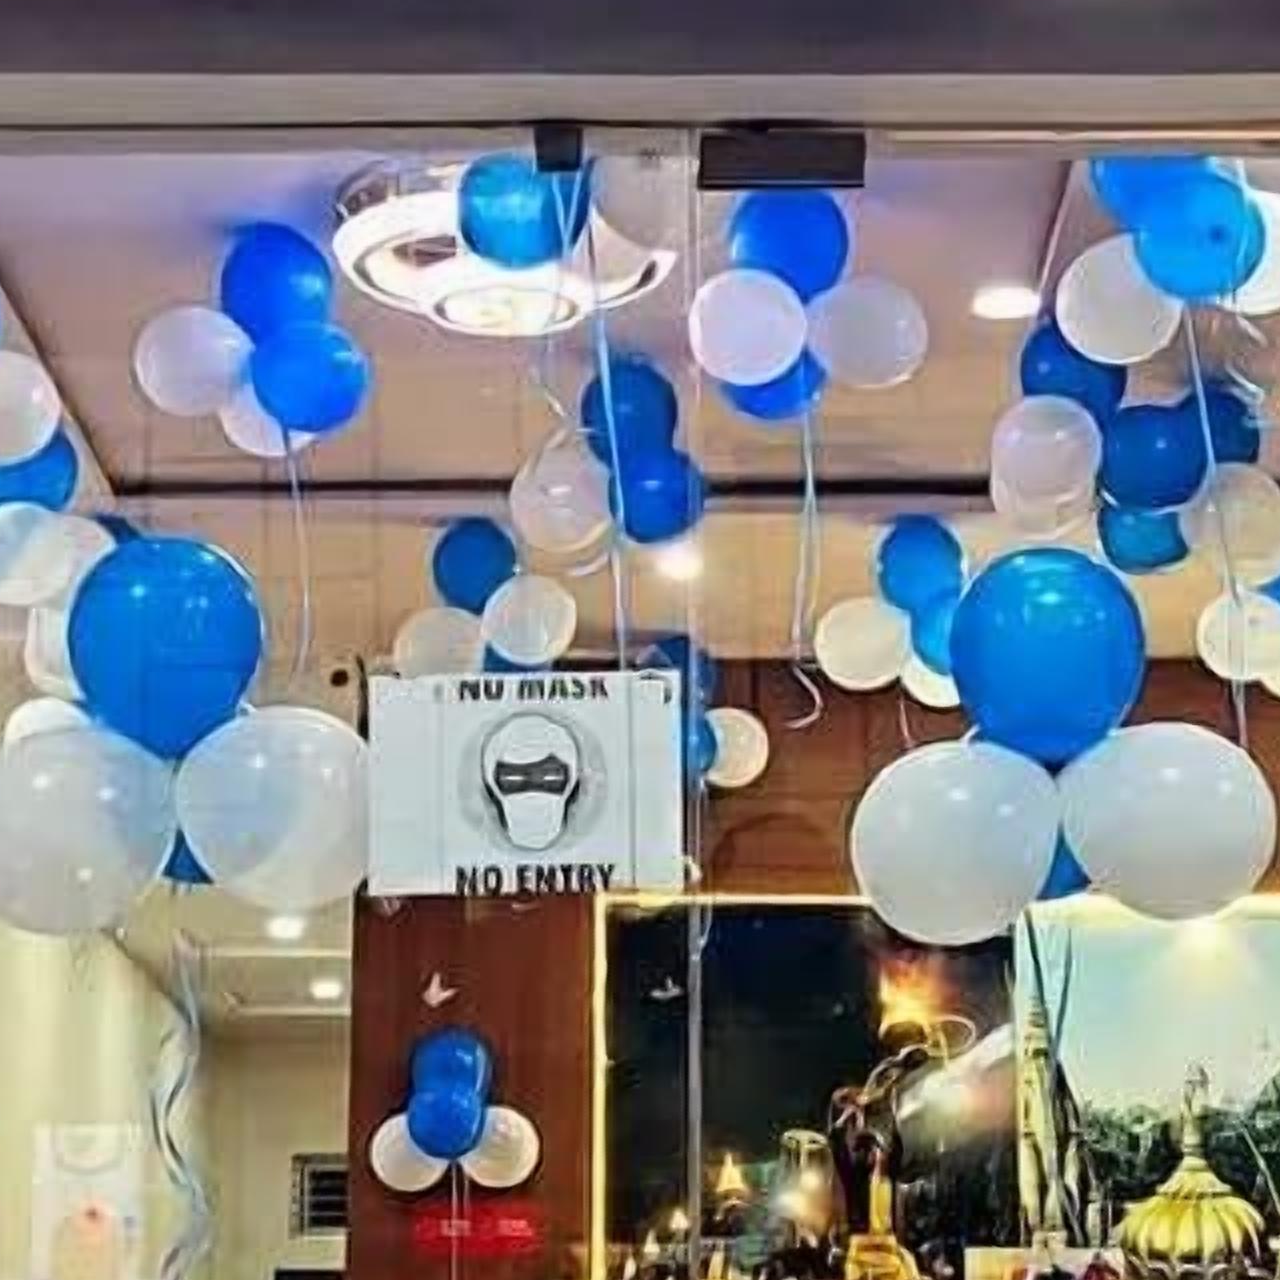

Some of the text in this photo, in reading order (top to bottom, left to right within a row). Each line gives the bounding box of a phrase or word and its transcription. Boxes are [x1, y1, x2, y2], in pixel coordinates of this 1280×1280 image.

[459, 677, 608, 701] NO MASK
[455, 863, 615, 897] NO ENTRY
